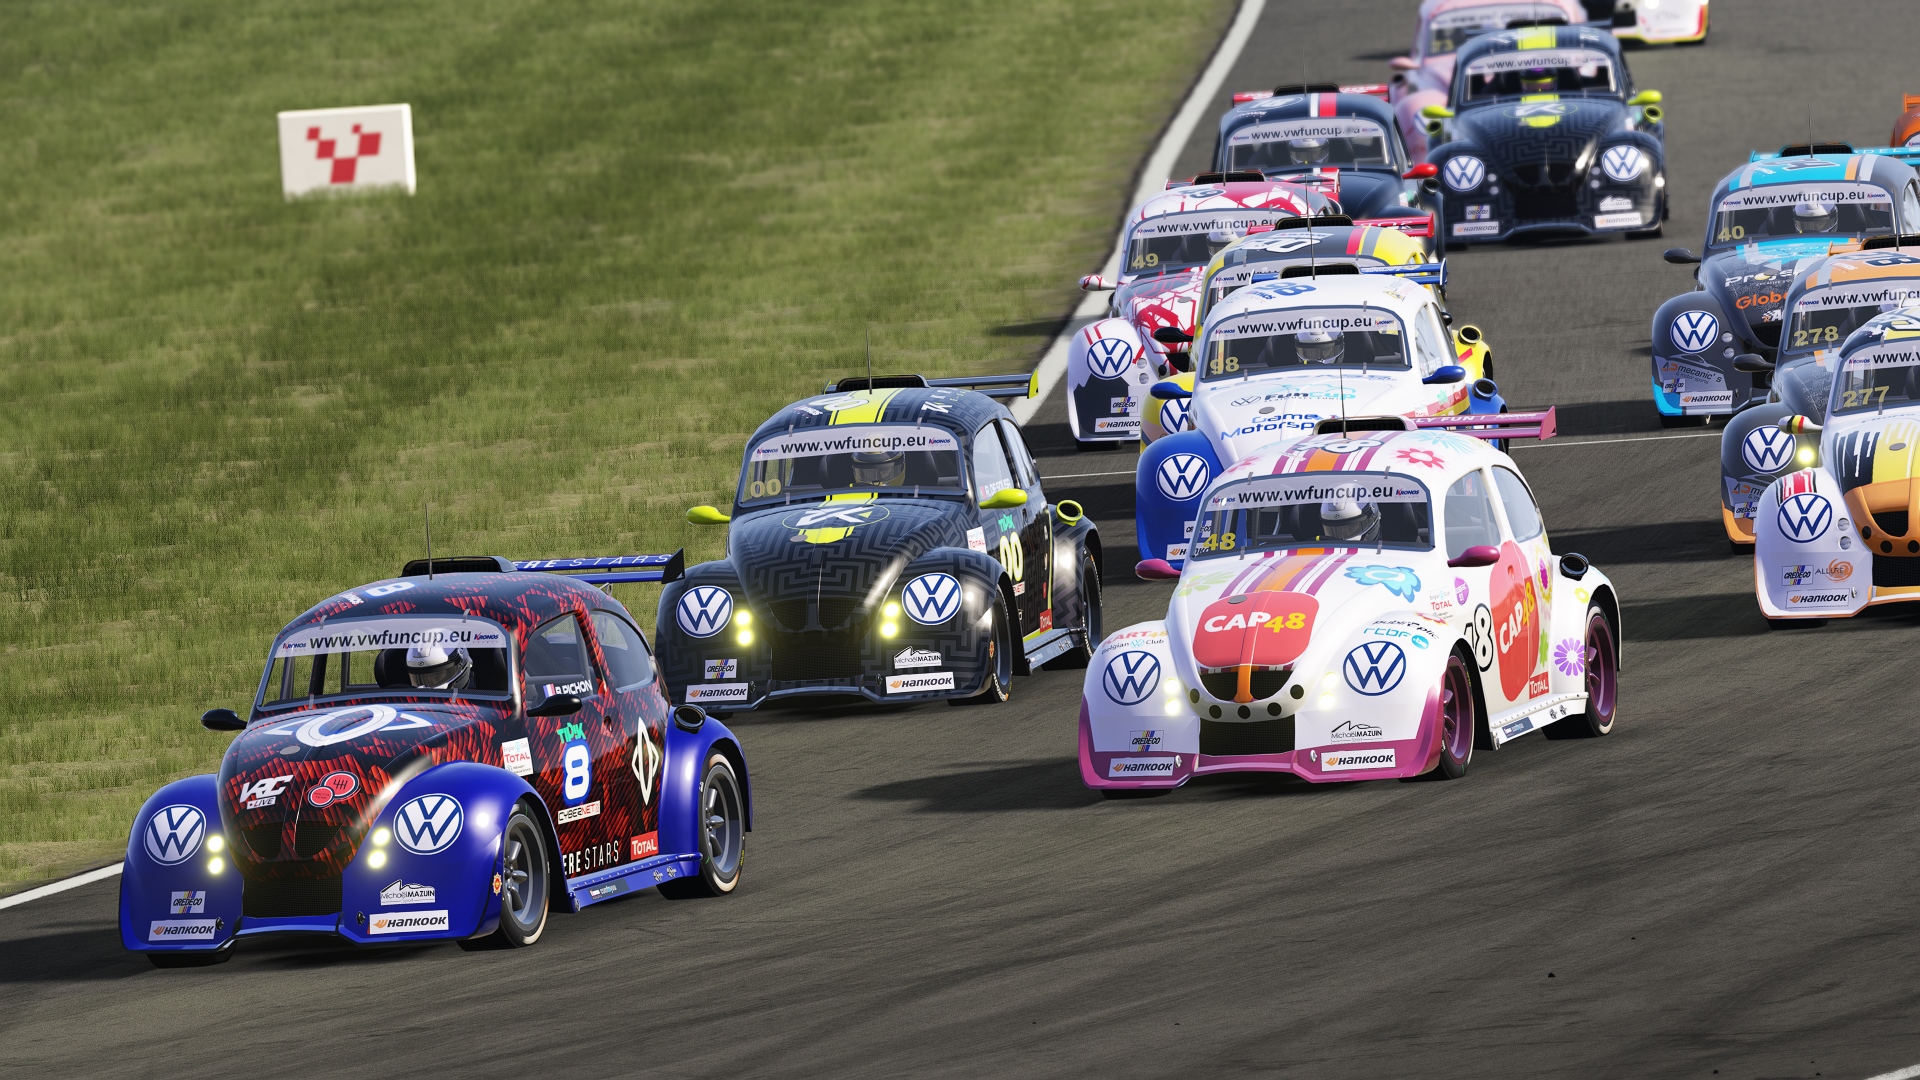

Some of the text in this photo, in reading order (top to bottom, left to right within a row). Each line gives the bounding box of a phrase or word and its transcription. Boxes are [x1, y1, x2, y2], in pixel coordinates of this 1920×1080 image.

[1486, 57, 1590, 70] www.vwfuncup.u
[1251, 127, 1360, 140] www.vwfuncup.u
[1602, 146, 1643, 180] VW
[1444, 156, 1484, 191] VW
[1743, 190, 1865, 206] www.vwfuncup.eu
[1718, 225, 1745, 242] 40
[1132, 253, 1159, 269] 49
[1821, 289, 1920, 306] www.vwfunc
[1237, 317, 1372, 334] www.vwfuncup.eu
[1669, 310, 1719, 353] VW
[1793, 326, 1839, 347] 278
[1087, 338, 1133, 379] VW
[1210, 356, 1240, 374] 98
[1842, 386, 1890, 408] 277
[1106, 420, 1141, 428] HANKOO
[1221, 421, 1315, 439] Motorsp
[781, 433, 927, 454] www.vwfuncup.eu
[1743, 426, 1796, 474] VW
[1157, 454, 1209, 500] VW
[750, 478, 782, 498] 00
[1238, 485, 1394, 503] www.vwfuncup.eu
[1777, 493, 1833, 544] VW
[1203, 532, 1237, 551] 48
[569, 554, 673, 567] STARS
[902, 573, 963, 625] VW
[1431, 600, 1453, 611] TOTAL
[677, 586, 733, 638] VW
[1499, 581, 1535, 654] CAP48
[1204, 612, 1306, 633] CAP48
[309, 630, 471, 648] www.vwfuncup.eu
[473, 633, 499, 641] KRONOS
[1103, 651, 1161, 706] VW
[1343, 641, 1406, 696] VW
[1530, 679, 1549, 694] TOTAL
[505, 752, 531, 763] TOTAL
[564, 744, 590, 800] 8
[144, 804, 206, 865] VW
[394, 794, 463, 855] VW
[584, 840, 620, 870] STARS
[631, 839, 658, 856] TOTAL
